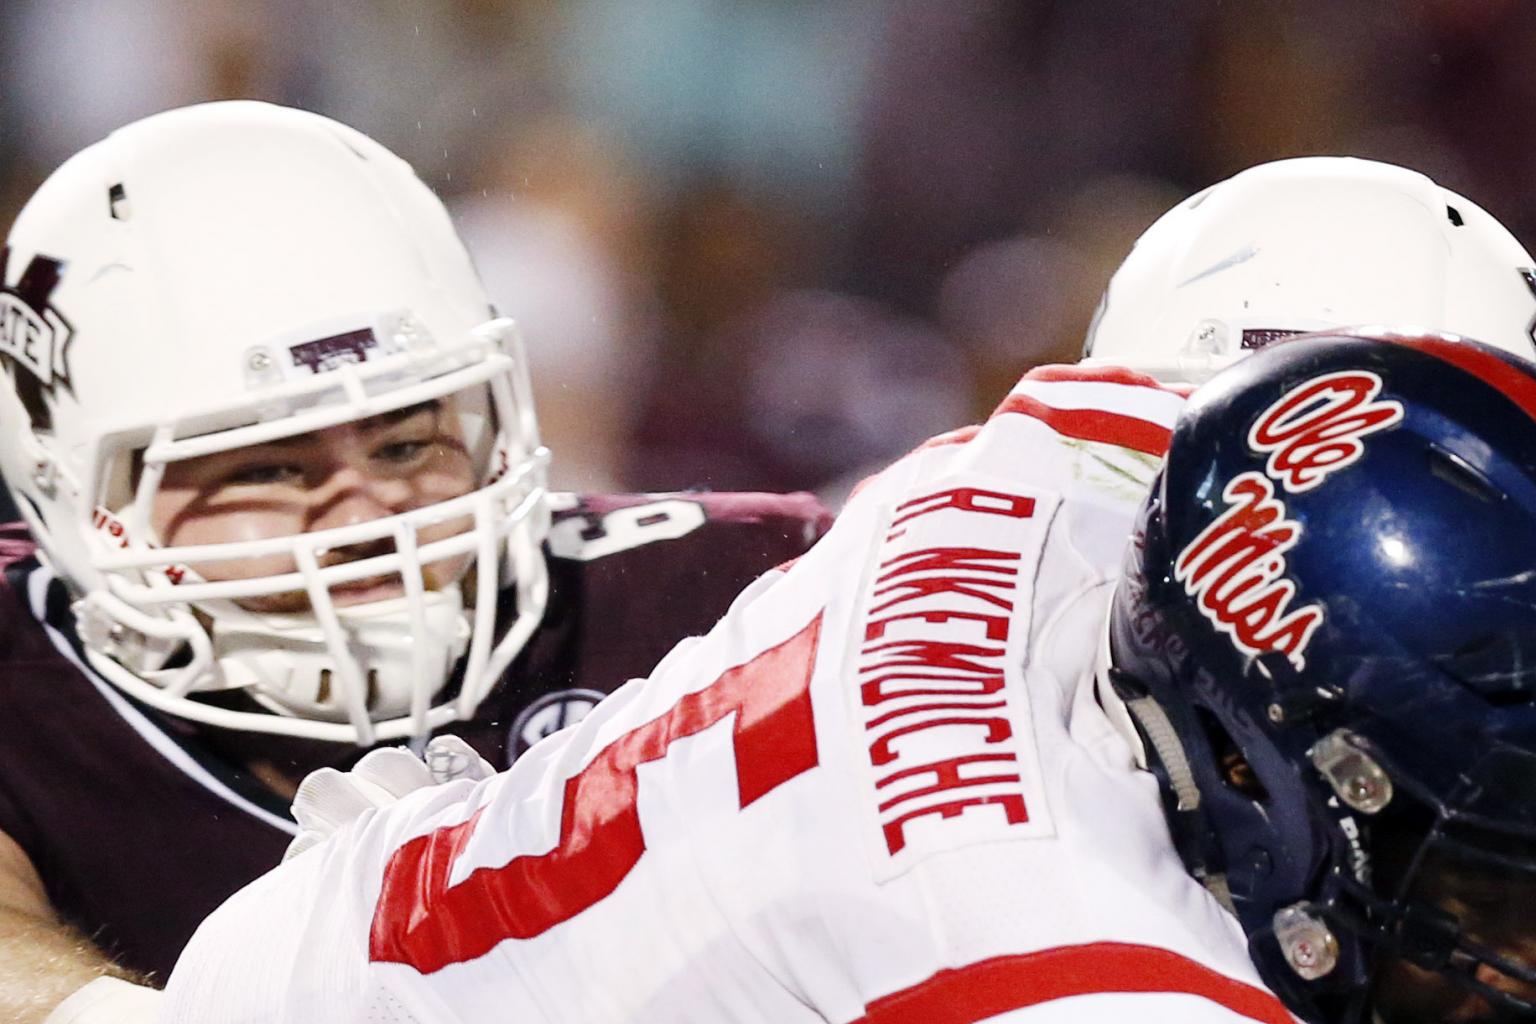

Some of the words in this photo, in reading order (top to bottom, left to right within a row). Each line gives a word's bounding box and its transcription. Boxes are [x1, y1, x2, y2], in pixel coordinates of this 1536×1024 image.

[1250, 371, 1403, 493] Ole
[1176, 472, 1323, 660] Miss
[369, 607, 819, 975] 5
[859, 547, 1029, 857] NKEMDICHE
